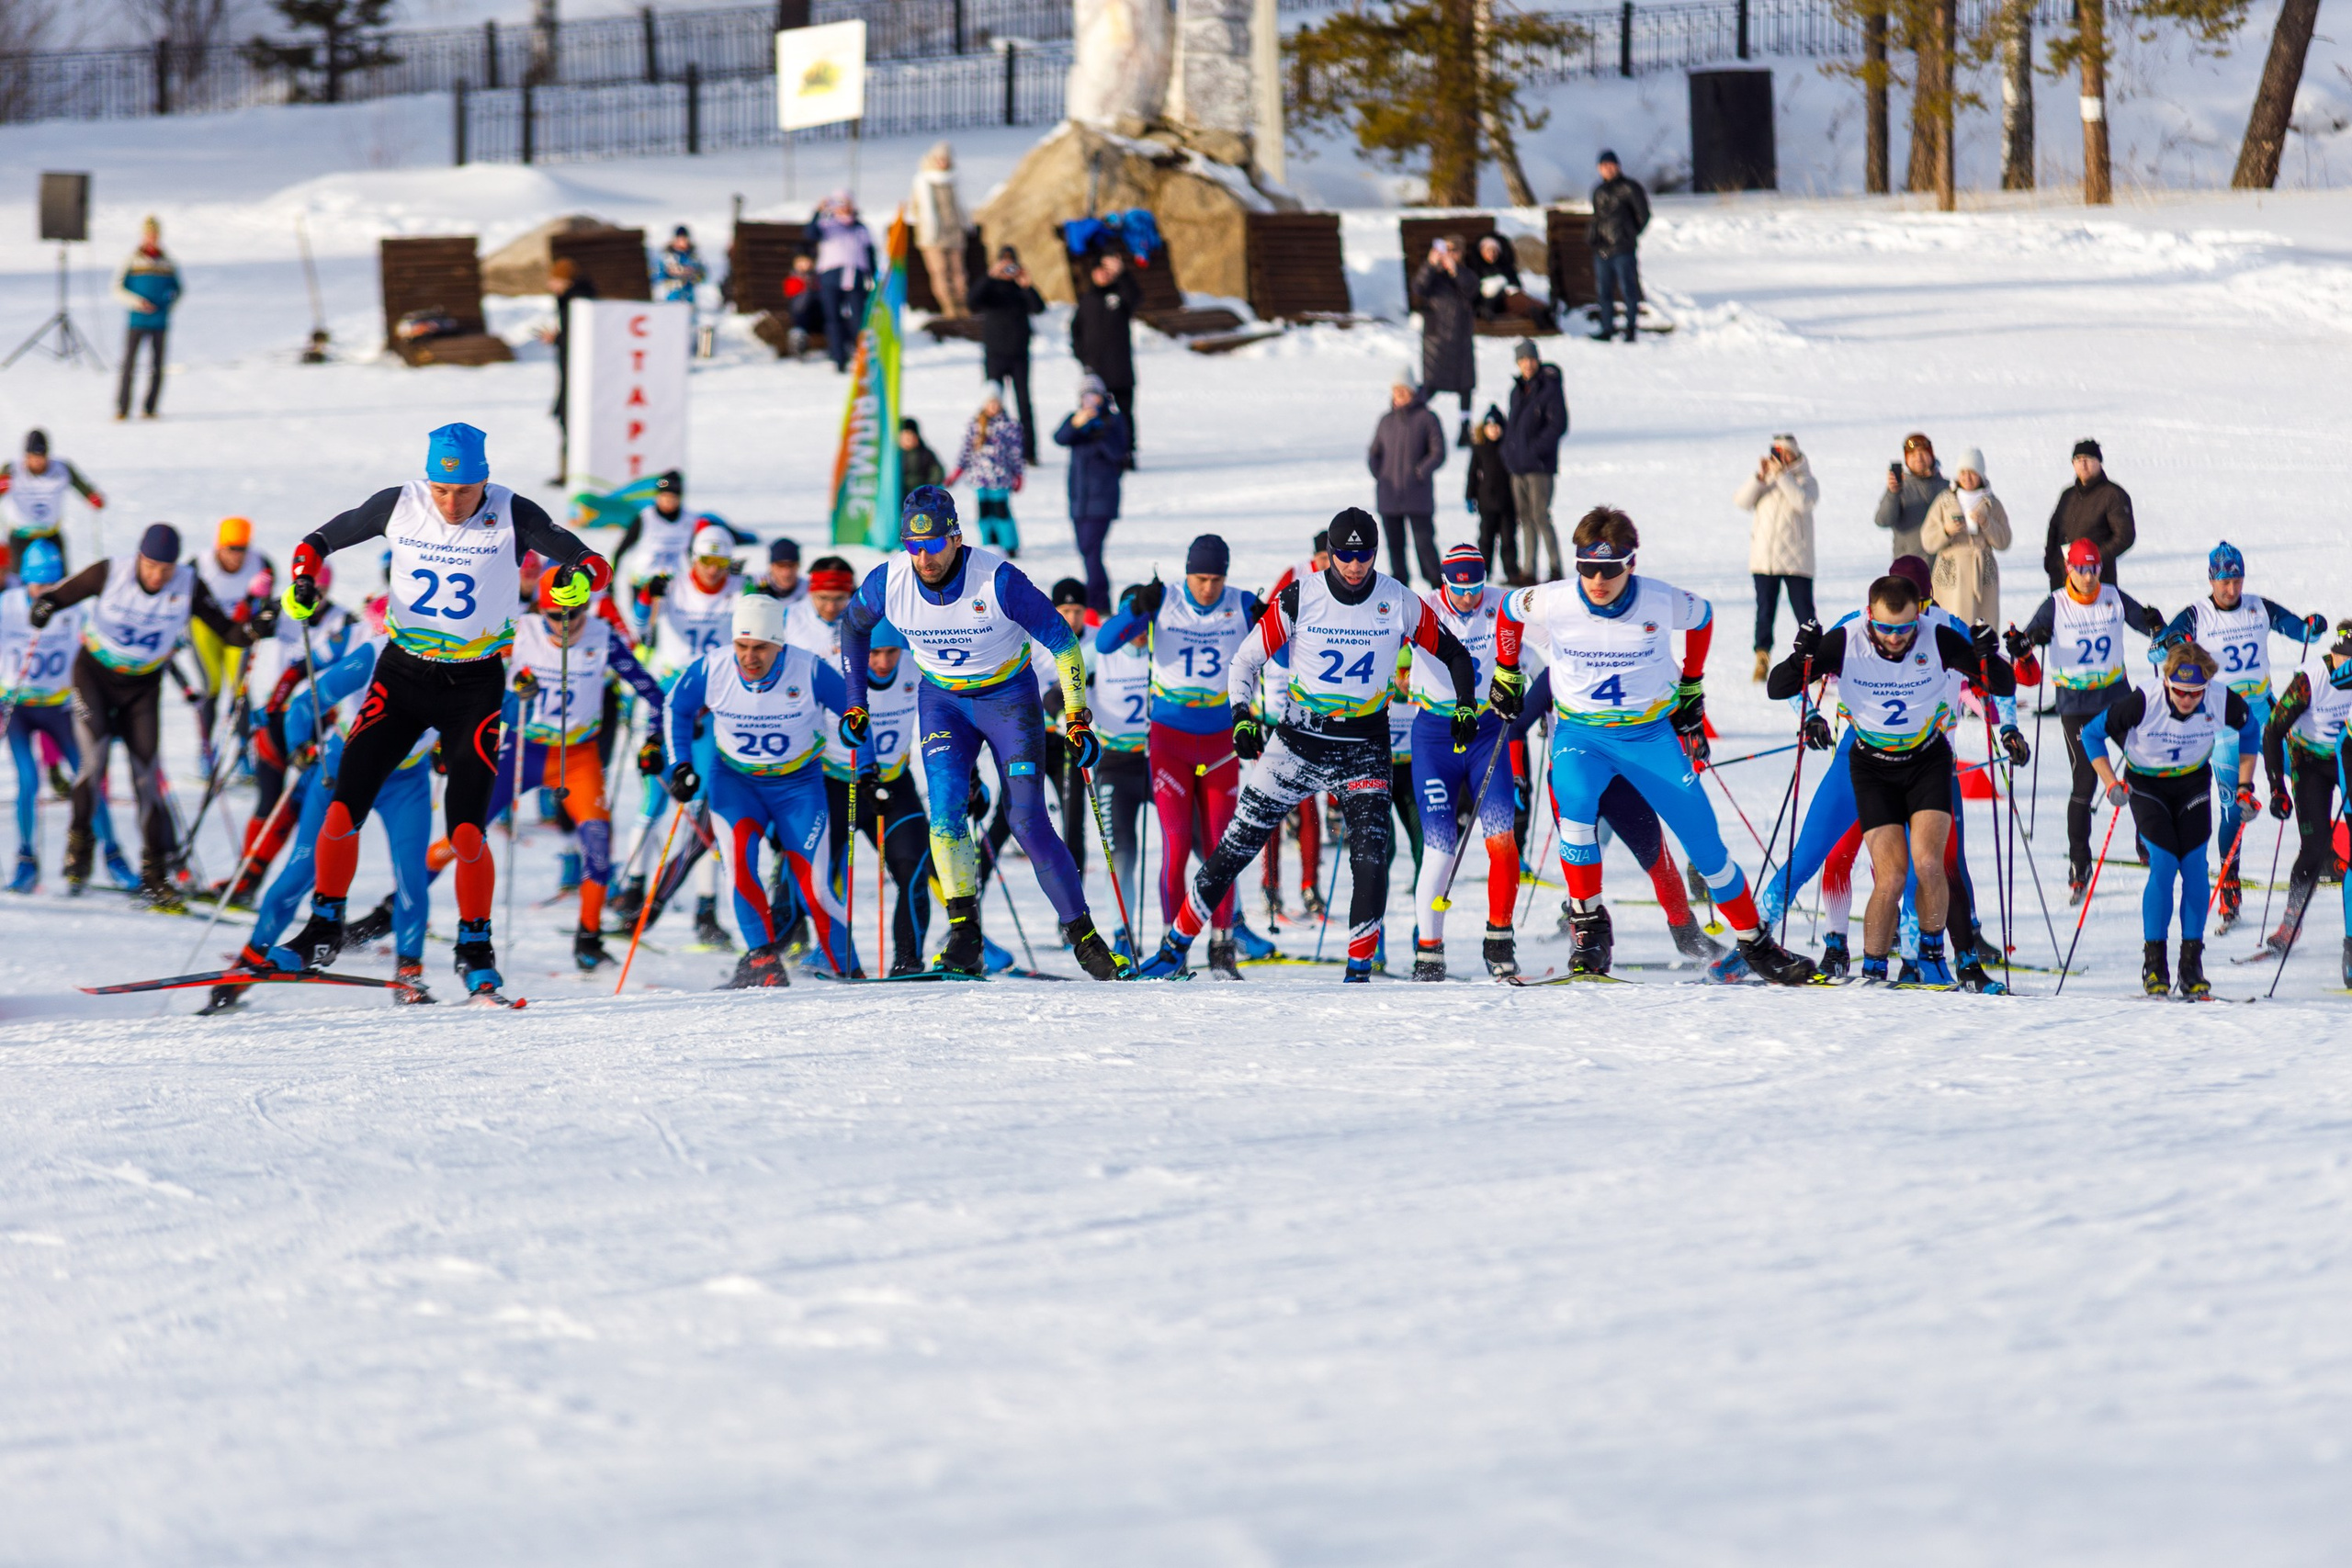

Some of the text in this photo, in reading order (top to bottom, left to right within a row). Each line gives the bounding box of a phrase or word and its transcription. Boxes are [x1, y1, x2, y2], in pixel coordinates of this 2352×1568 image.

[627, 314, 650, 477] СТАРТ
[398, 536, 498, 555] БЕЛОКУРИХИНСКИЙ
[419, 553, 471, 566] МАРАФОН
[409, 569, 477, 620] 23
[115, 623, 163, 651] 34
[684, 627, 720, 656] 16
[899, 626, 993, 637] БЕЛОКУРИХИНСКИЙ
[922, 637, 972, 645] МАРАФОН
[1306, 626, 1390, 637] БЕЛОКУРИХИНСКИЙ
[1327, 637, 1371, 646] МАРАФОН
[937, 648, 970, 667] 9
[1179, 646, 1222, 678] 13
[2076, 636, 2112, 665] 29
[2222, 641, 2261, 672] 32
[1071, 664, 1081, 691] KAZ
[1318, 649, 1375, 684] 24
[537, 686, 575, 717] 12
[1591, 673, 1627, 706] 4
[1125, 694, 1146, 724] 2
[1882, 699, 1909, 726] 2
[732, 732, 791, 757] 20
[876, 729, 899, 755] 0
[921, 730, 953, 749] KAZ
[2167, 747, 2182, 762] 1
[1559, 843, 1590, 863] SSIA
